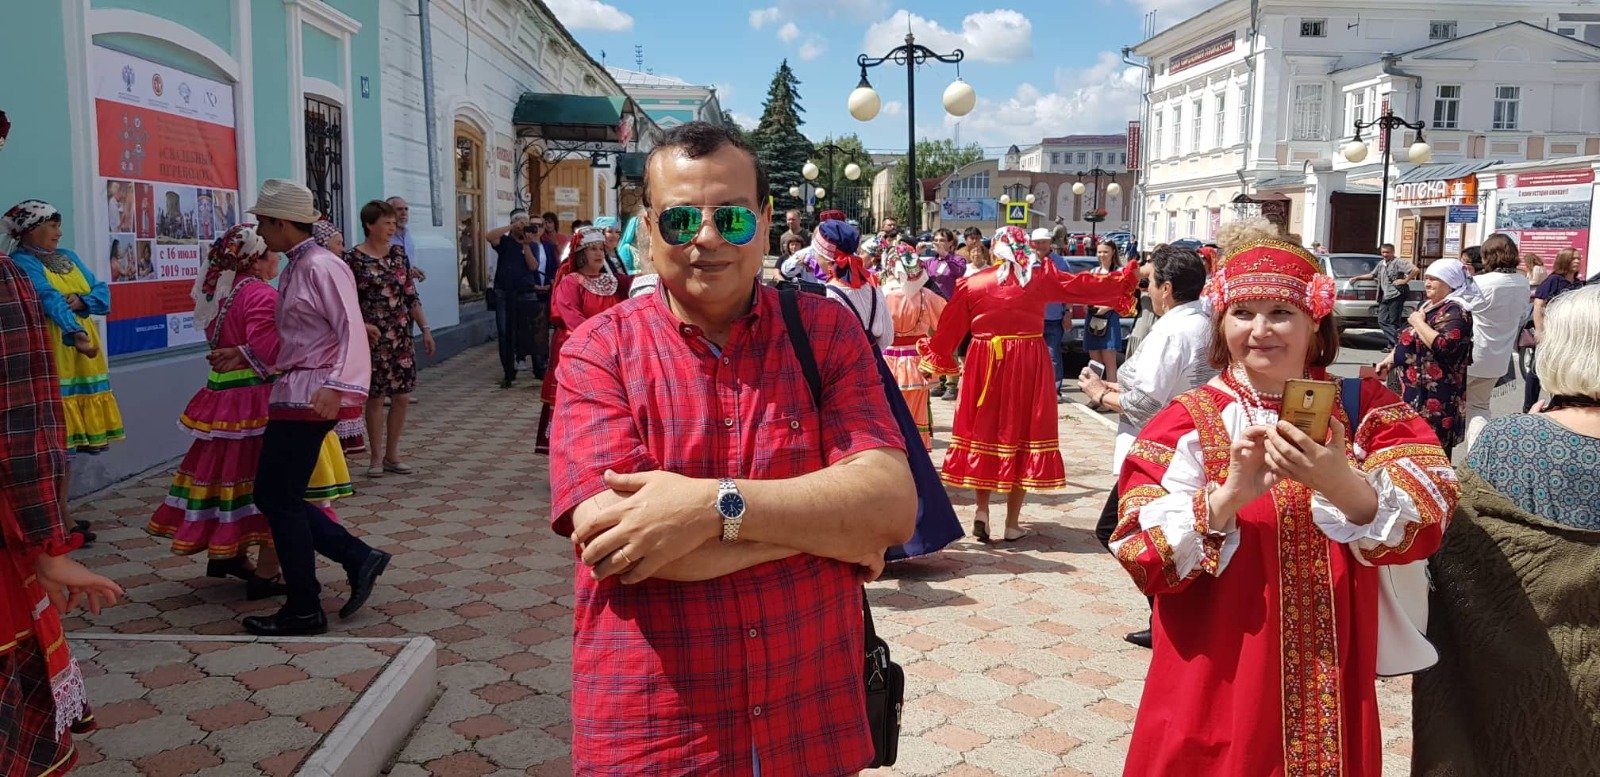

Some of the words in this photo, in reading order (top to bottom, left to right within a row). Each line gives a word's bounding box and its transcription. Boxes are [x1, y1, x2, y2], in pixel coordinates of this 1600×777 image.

[159, 250, 165, 260] с
[167, 247, 176, 260] 16
[178, 250, 197, 260] июля
[161, 264, 179, 277] 2019
[182, 266, 198, 276] года
